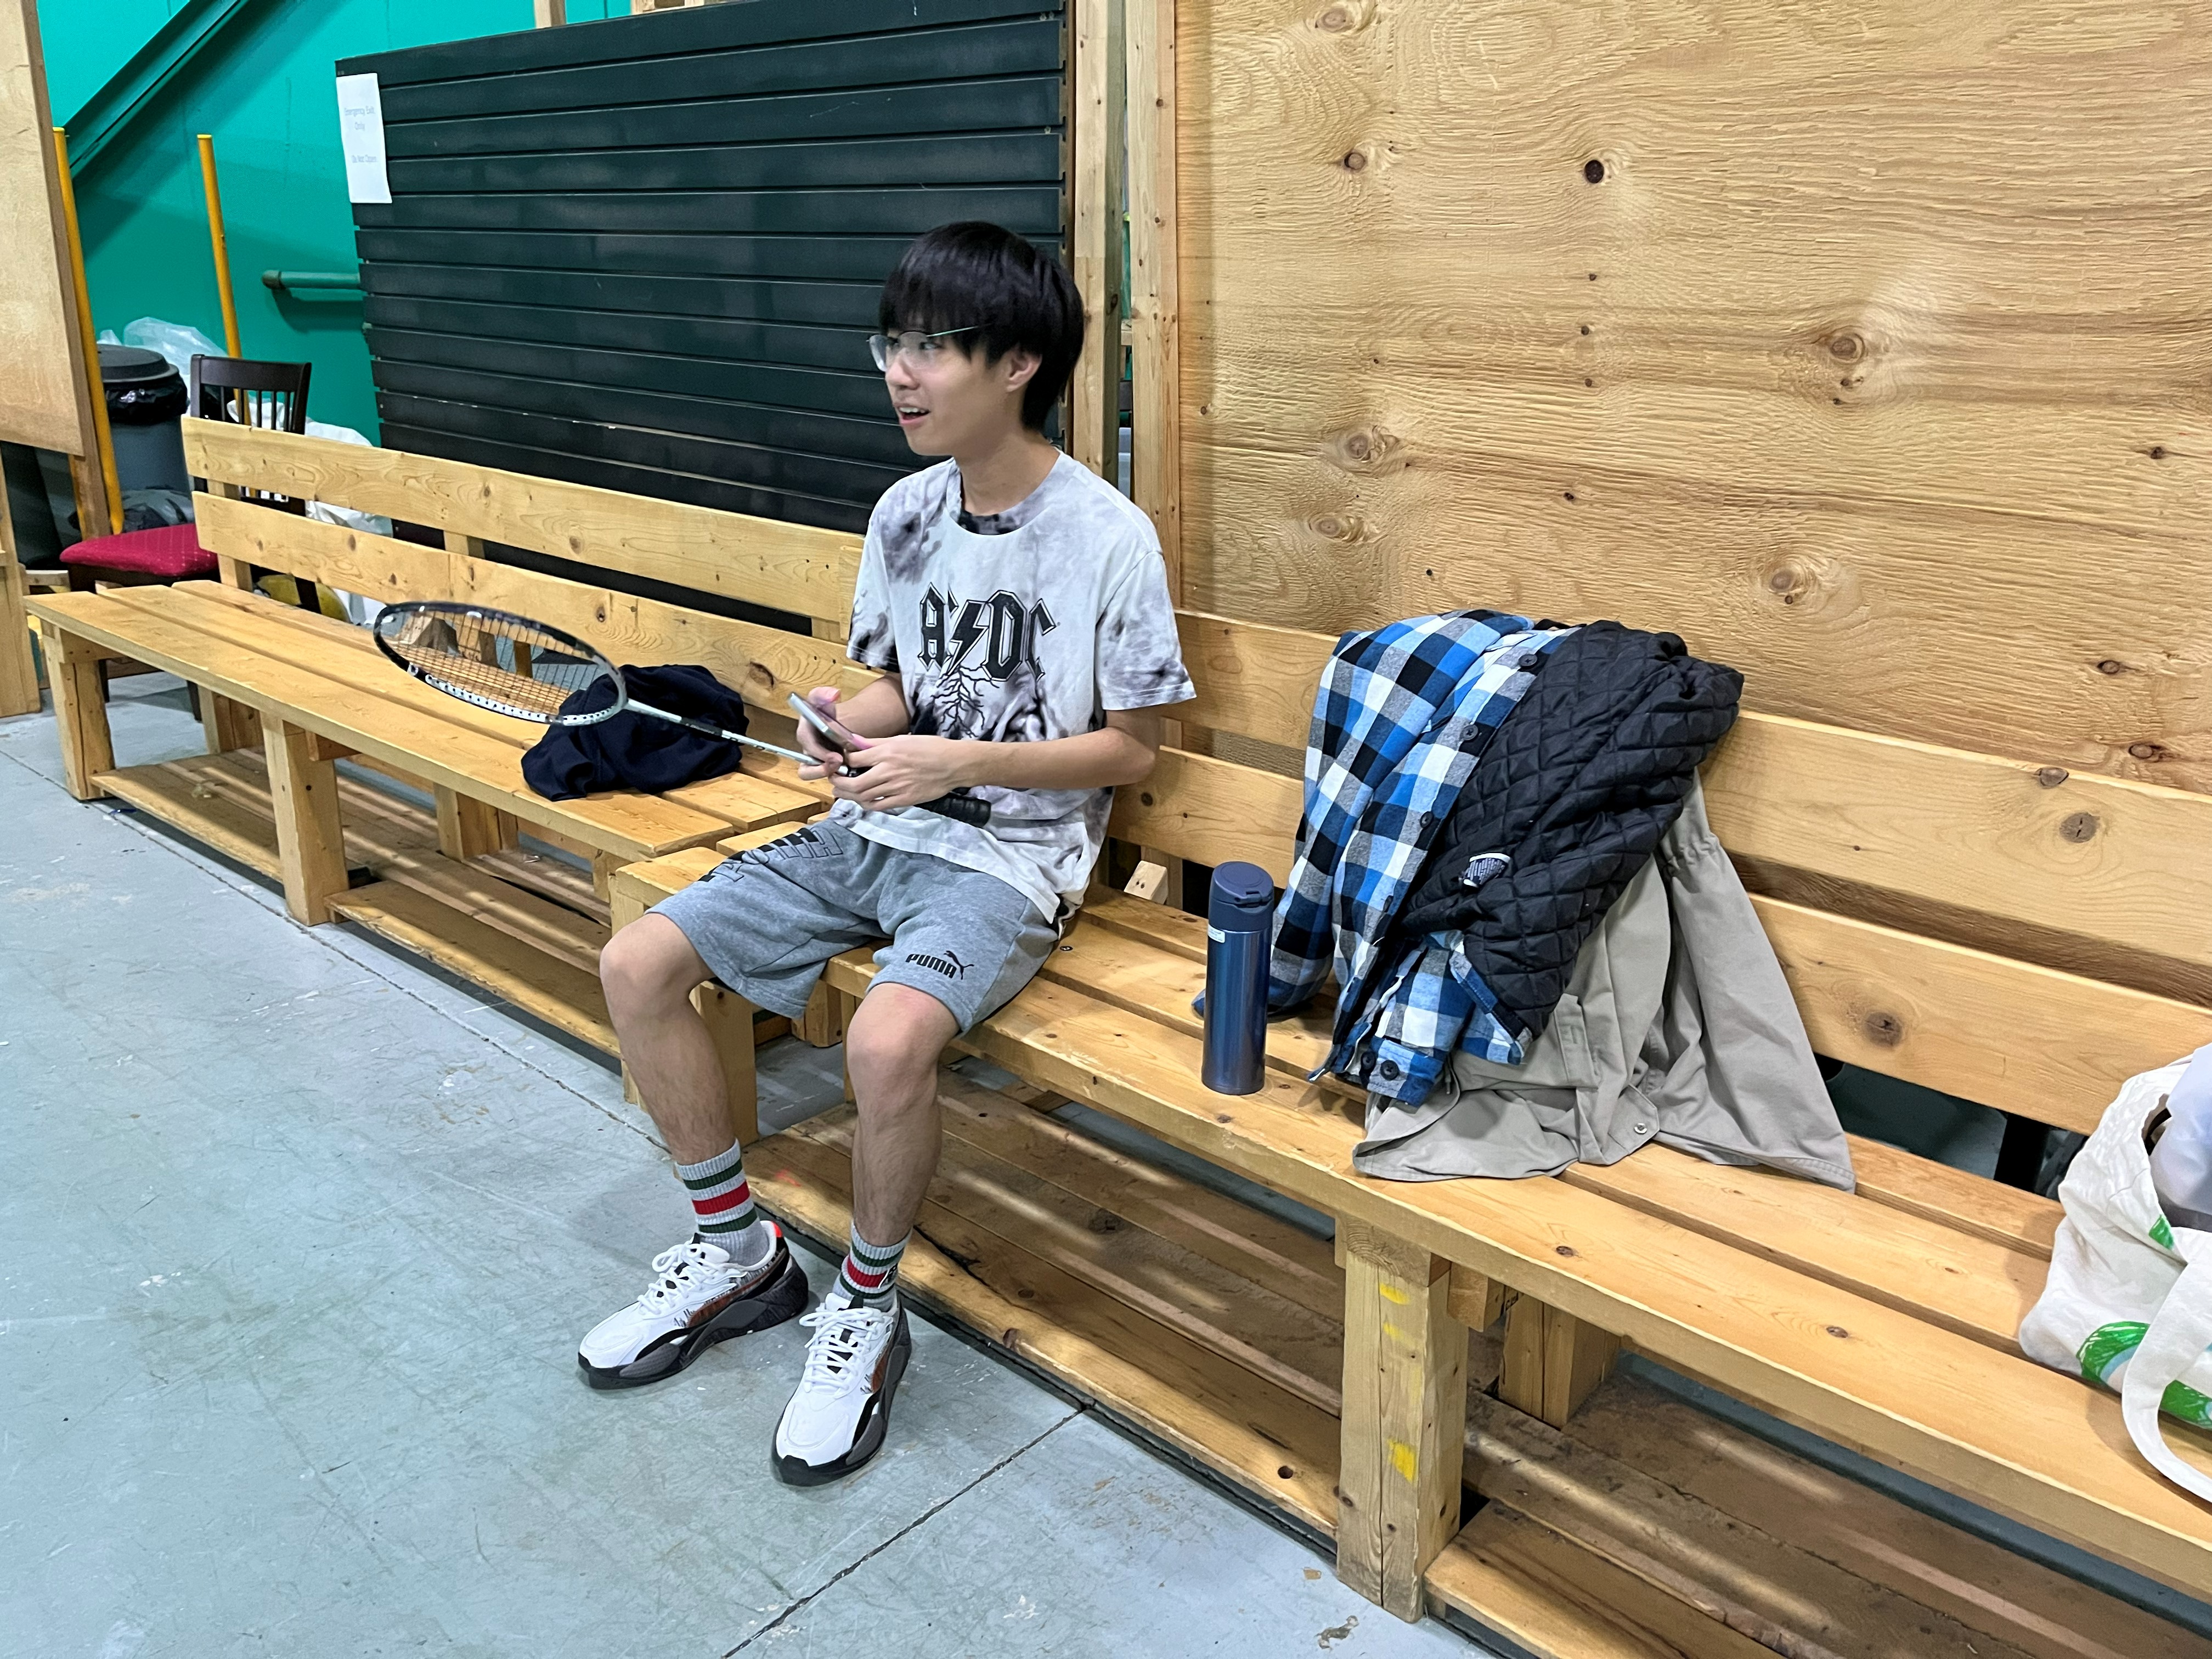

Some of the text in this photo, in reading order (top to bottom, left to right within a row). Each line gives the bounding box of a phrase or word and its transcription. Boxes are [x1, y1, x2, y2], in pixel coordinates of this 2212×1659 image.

[344, 105, 376, 117] Emergency Exit
[354, 121, 365, 131] Only
[905, 954, 957, 979] PUMA
